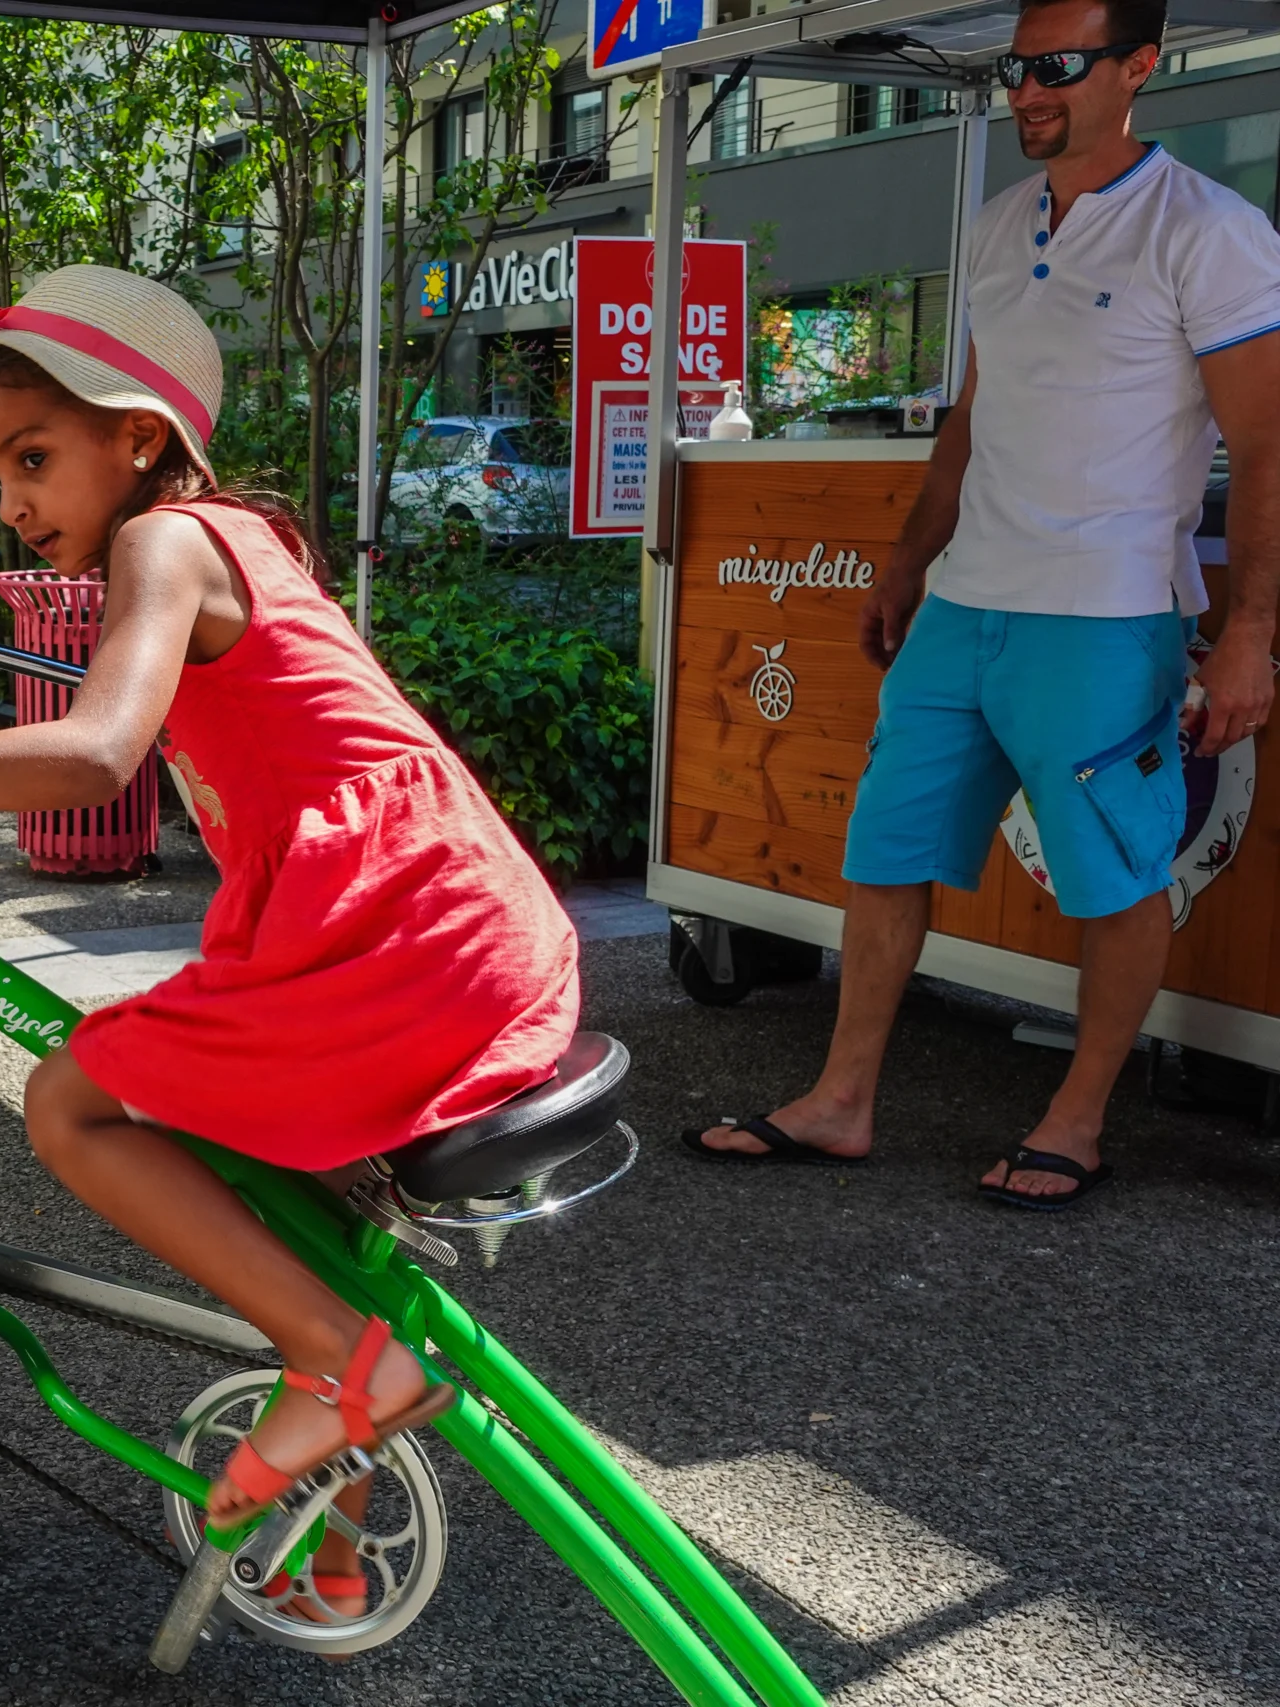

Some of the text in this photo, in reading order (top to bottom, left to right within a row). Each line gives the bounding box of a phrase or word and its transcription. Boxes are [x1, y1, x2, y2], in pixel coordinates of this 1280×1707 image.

[600, 303, 727, 335] DO DE
[620, 342, 721, 376] SNG
[612, 427, 629, 438] CET
[613, 443, 647, 457] MAISO
[614, 475, 639, 484] LES
[613, 488, 641, 499] 4 JUIL
[718, 542, 874, 603] mixyclette
